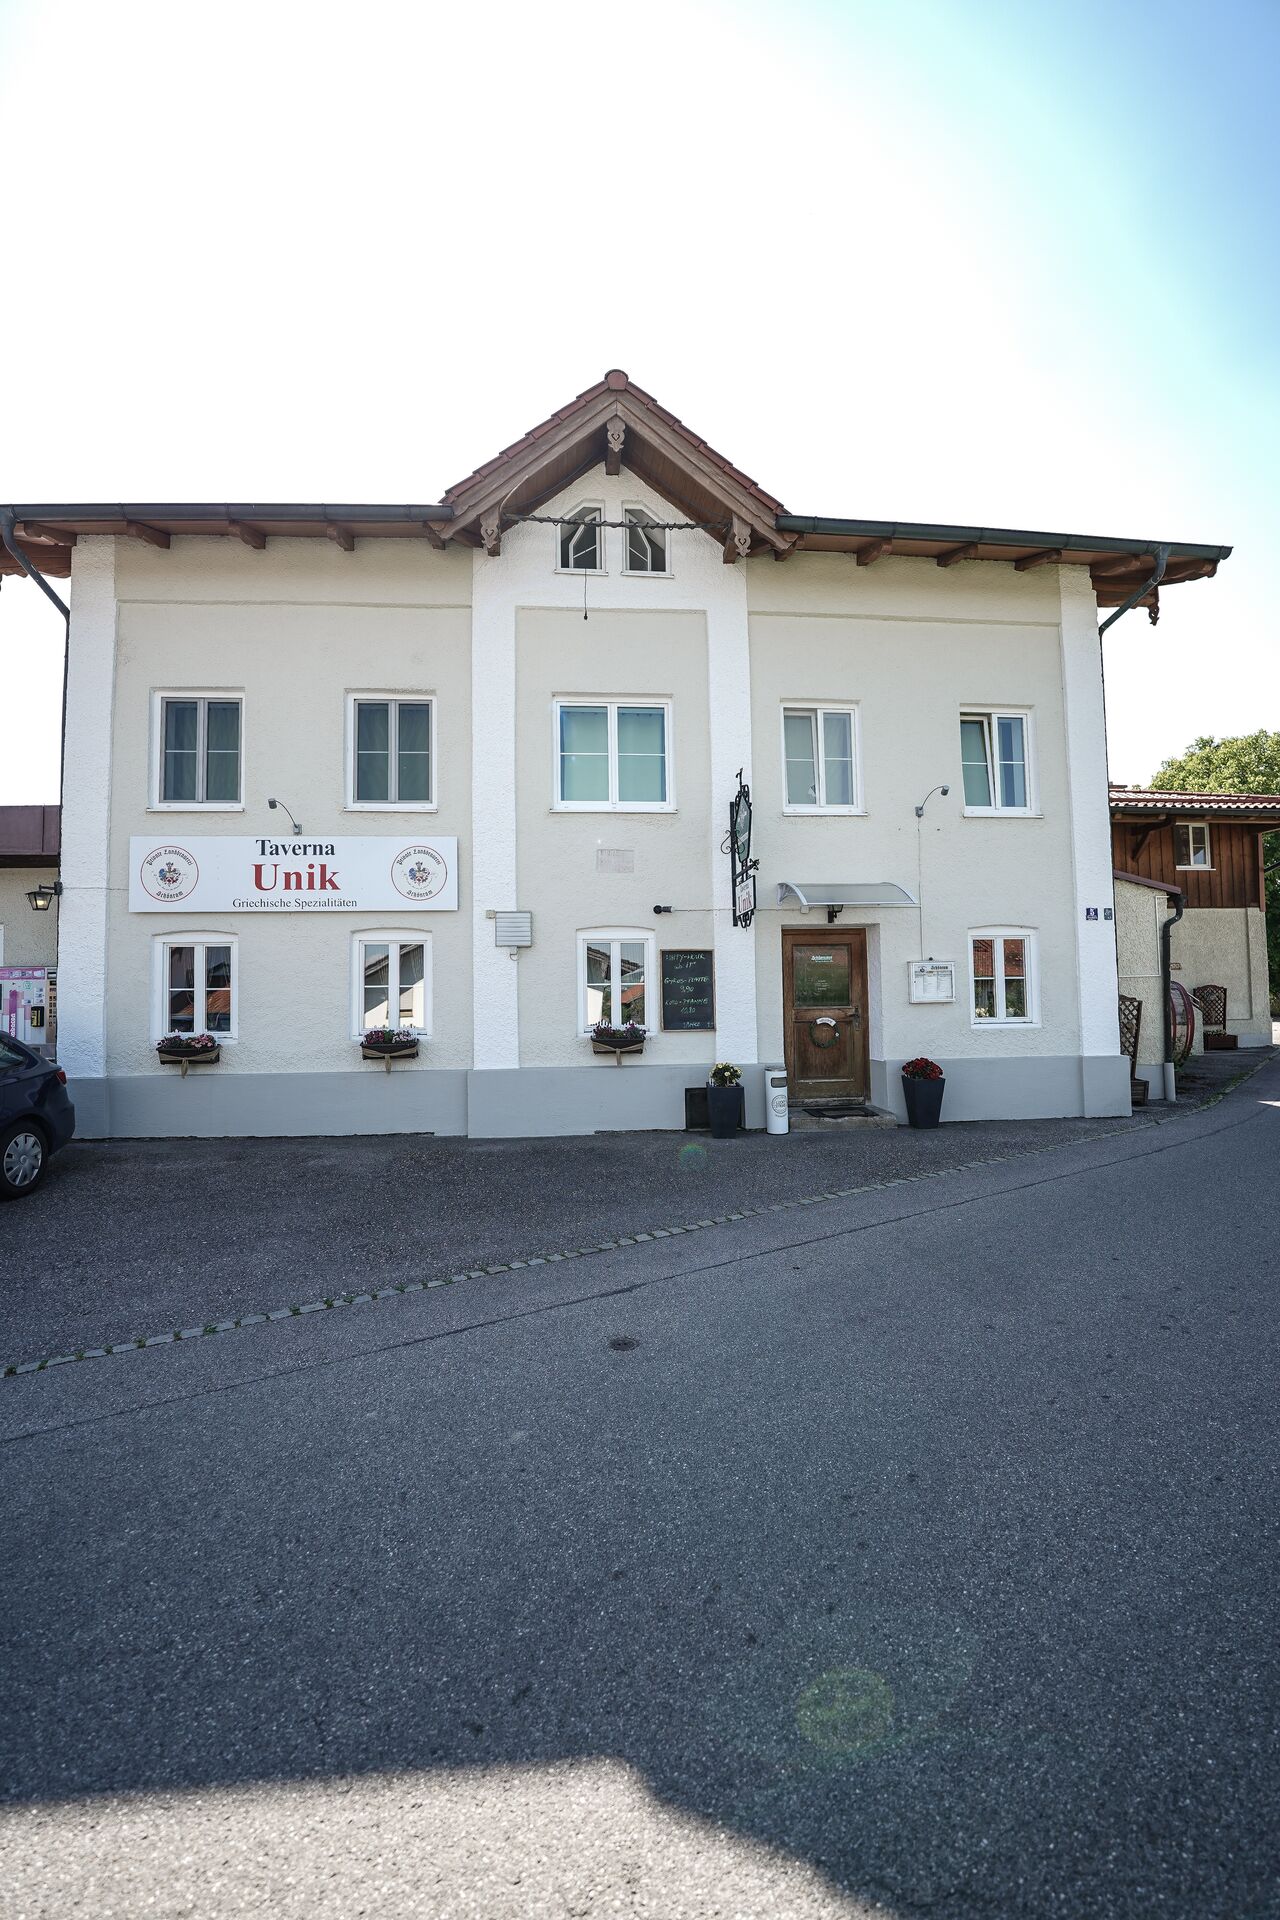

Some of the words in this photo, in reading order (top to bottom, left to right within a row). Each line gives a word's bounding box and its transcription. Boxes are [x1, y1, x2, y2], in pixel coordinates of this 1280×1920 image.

[256, 839, 336, 856] Taverna
[251, 863, 342, 891] Unik
[232, 898, 292, 908] Griechische
[294, 897, 358, 909] Spezialitäten
